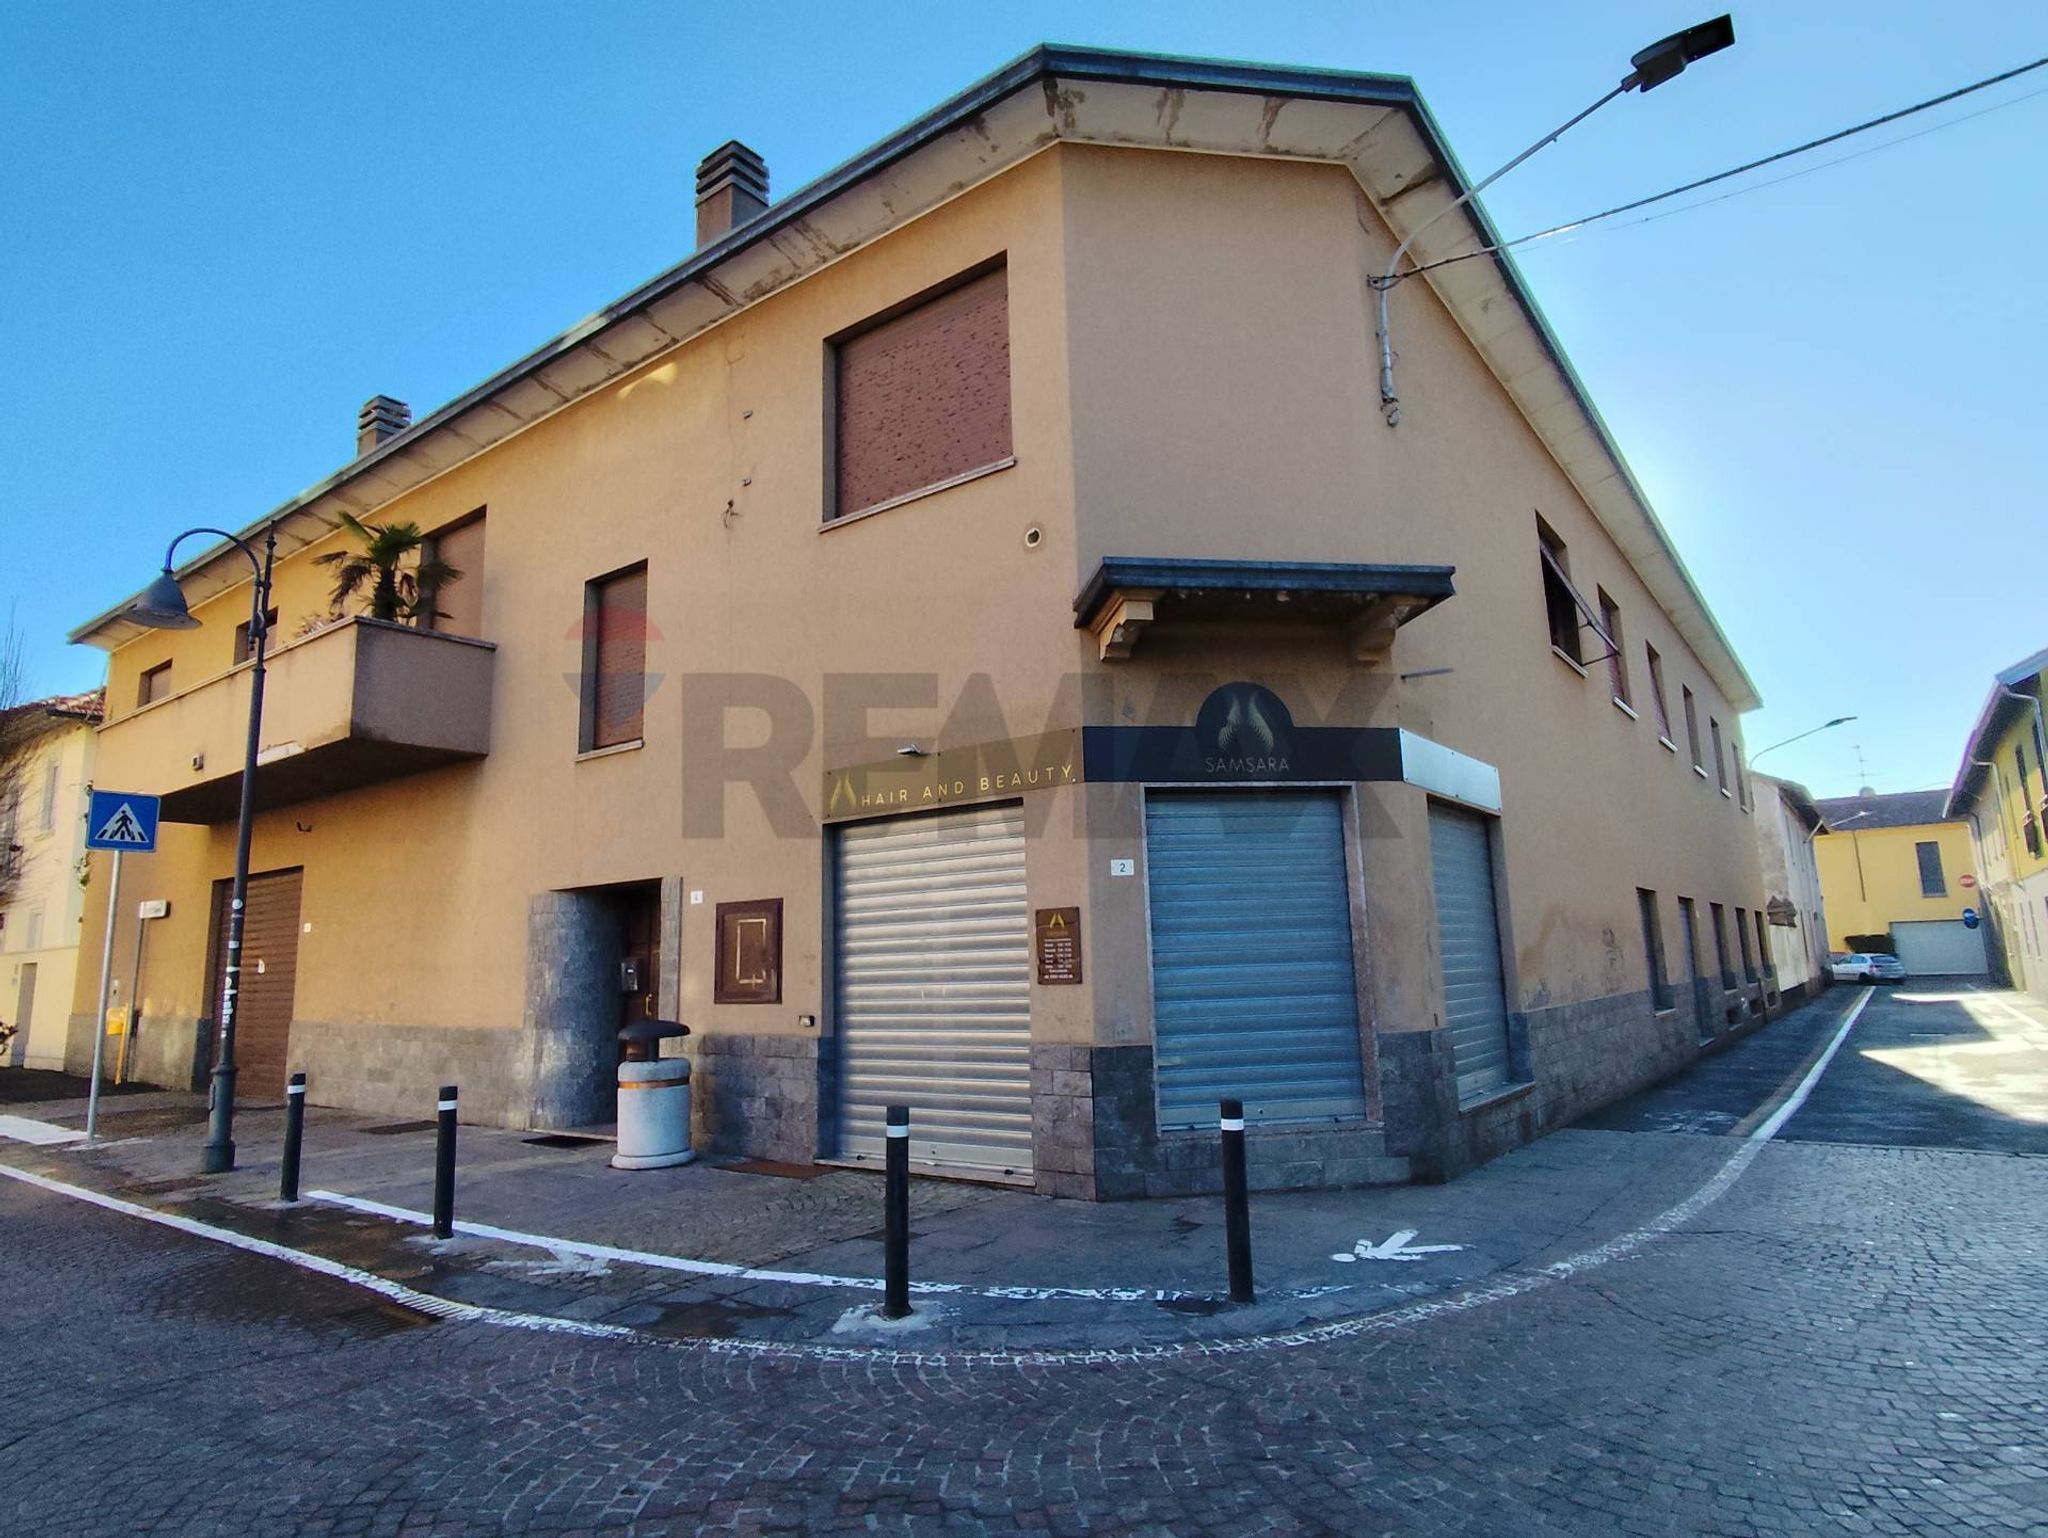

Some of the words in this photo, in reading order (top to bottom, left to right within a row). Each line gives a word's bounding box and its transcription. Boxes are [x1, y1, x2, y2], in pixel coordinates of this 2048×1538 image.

[1205, 757, 1290, 773] SAMSARA
[861, 789, 908, 807] HAIR
[923, 781, 964, 799] AND
[1119, 862, 1126, 873] 2
